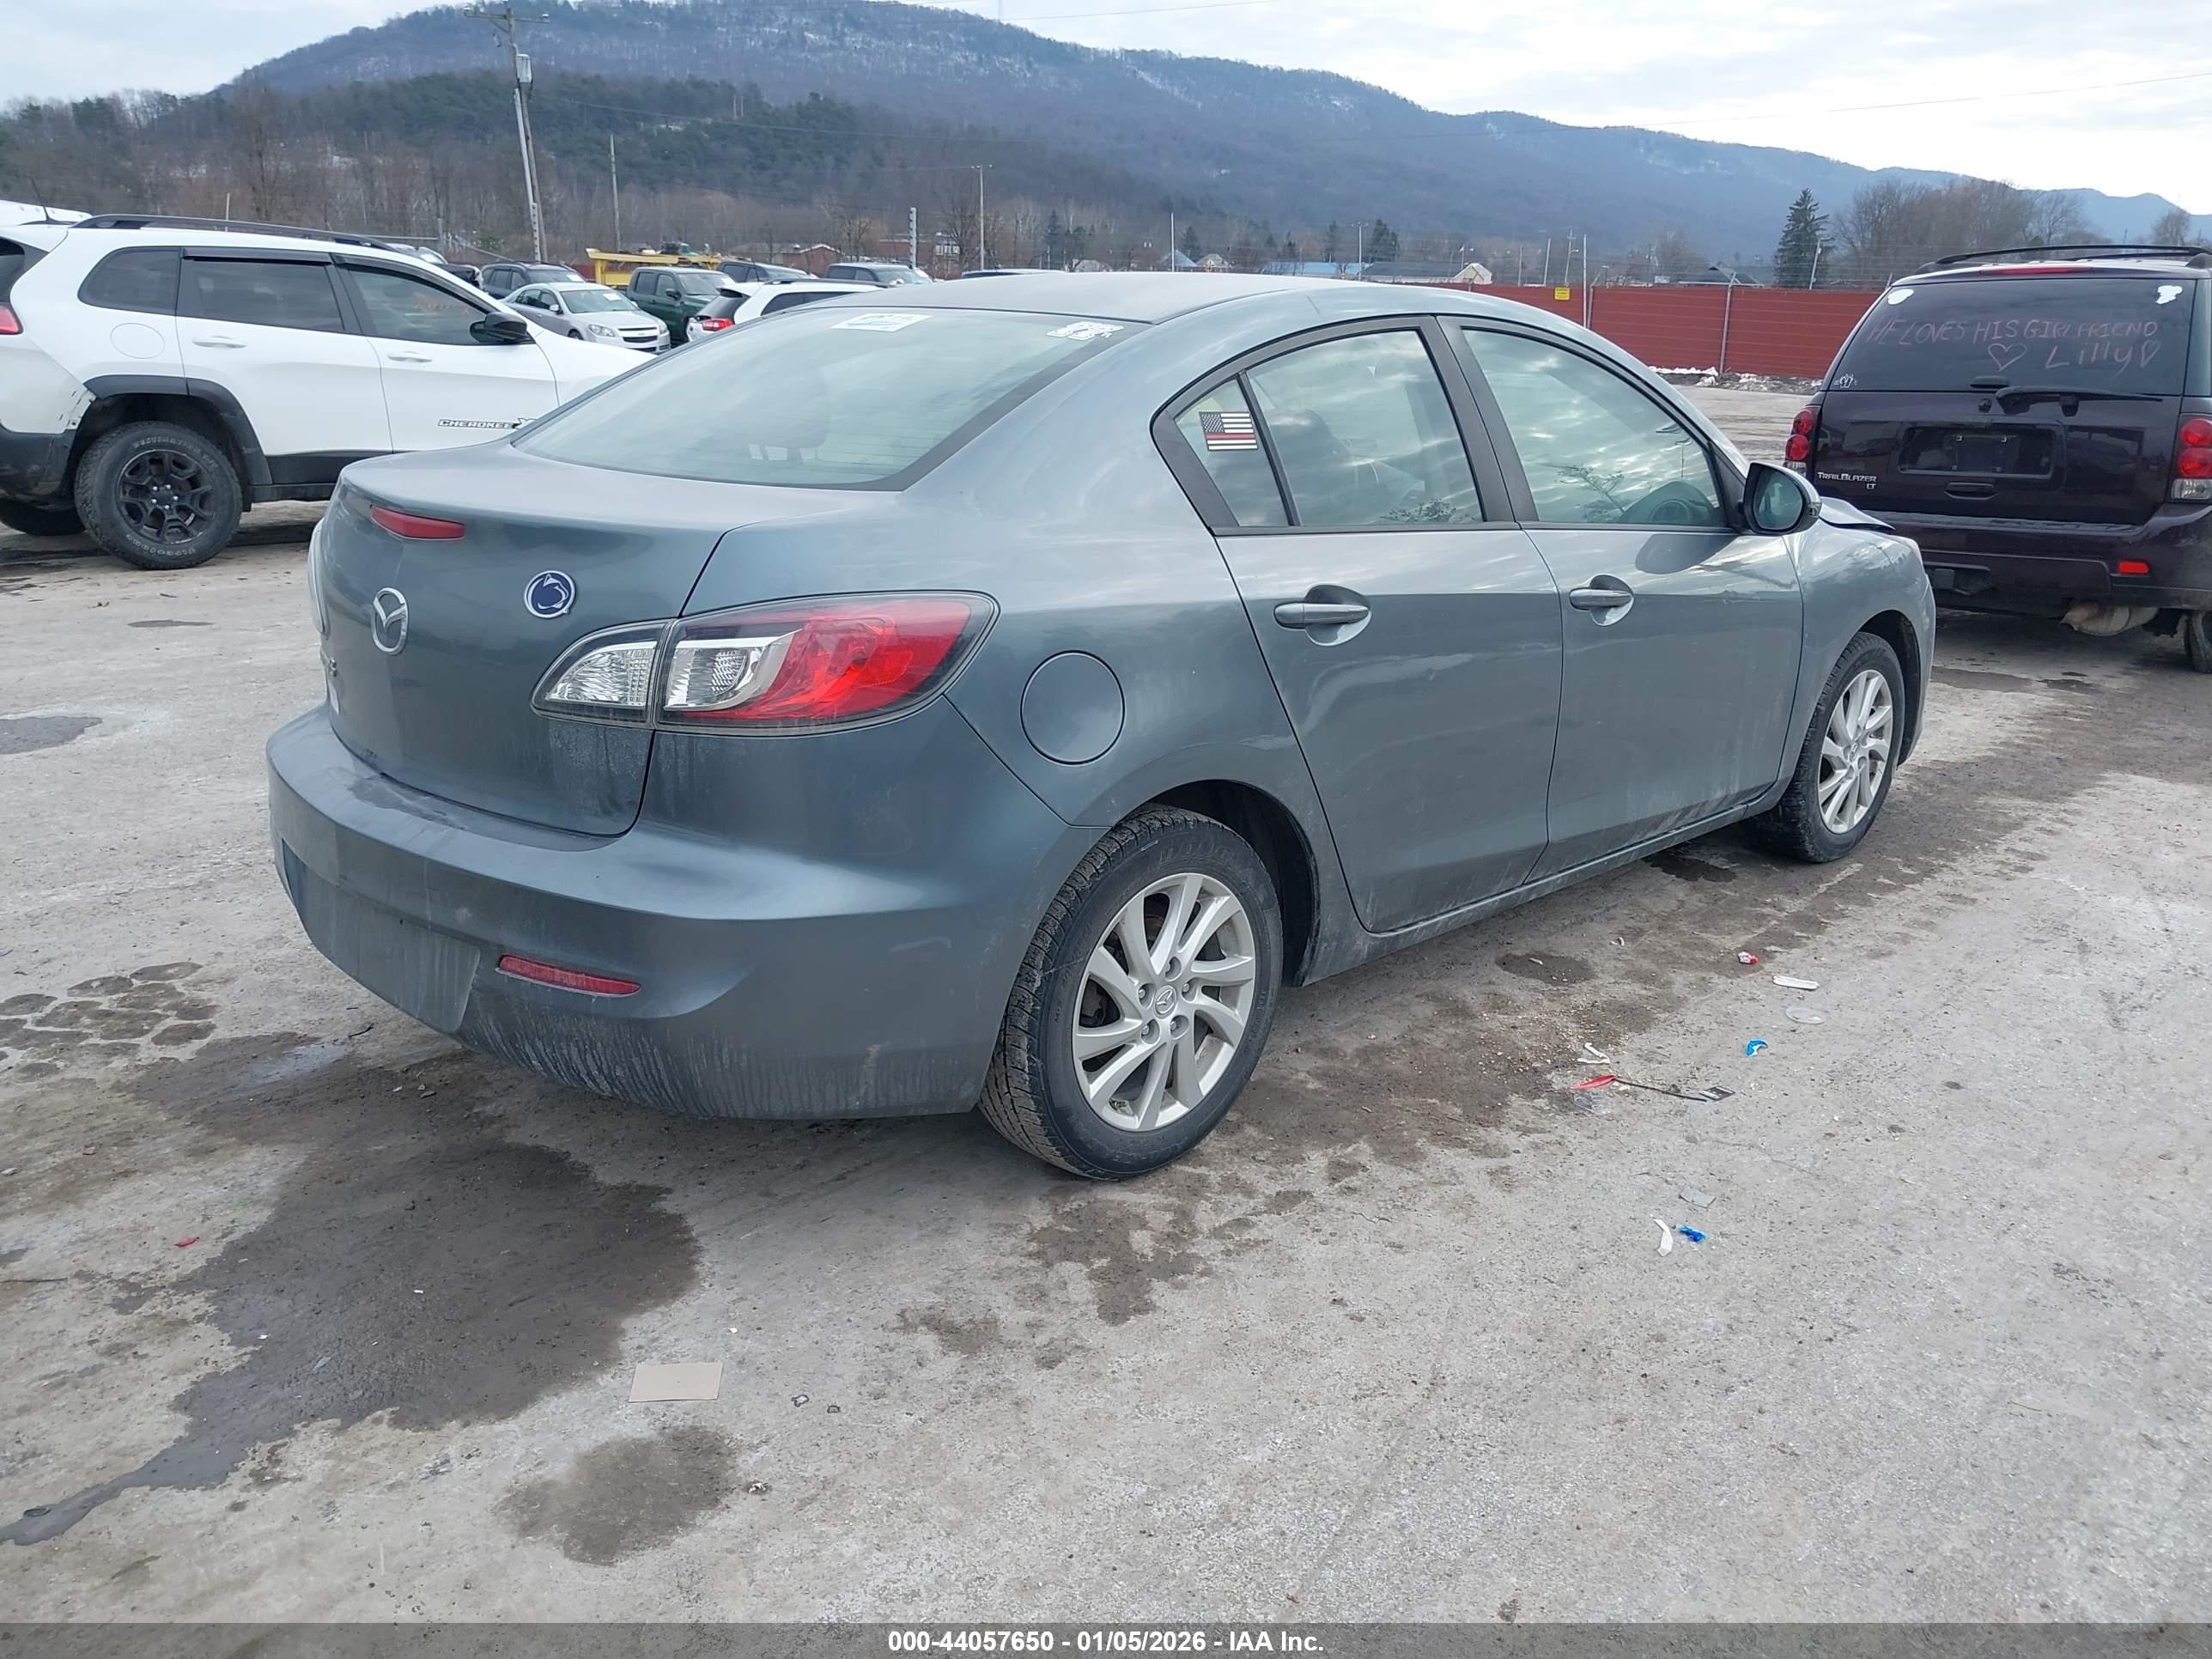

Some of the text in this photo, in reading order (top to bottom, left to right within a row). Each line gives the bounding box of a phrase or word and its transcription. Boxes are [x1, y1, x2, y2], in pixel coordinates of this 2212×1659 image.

[1868, 319, 1907, 344] HE
[1899, 320, 1968, 345] LOVES
[1972, 319, 2020, 343] HIS
[2045, 341, 2134, 378] Lilly
[437, 418, 514, 429] CHEROKEE
